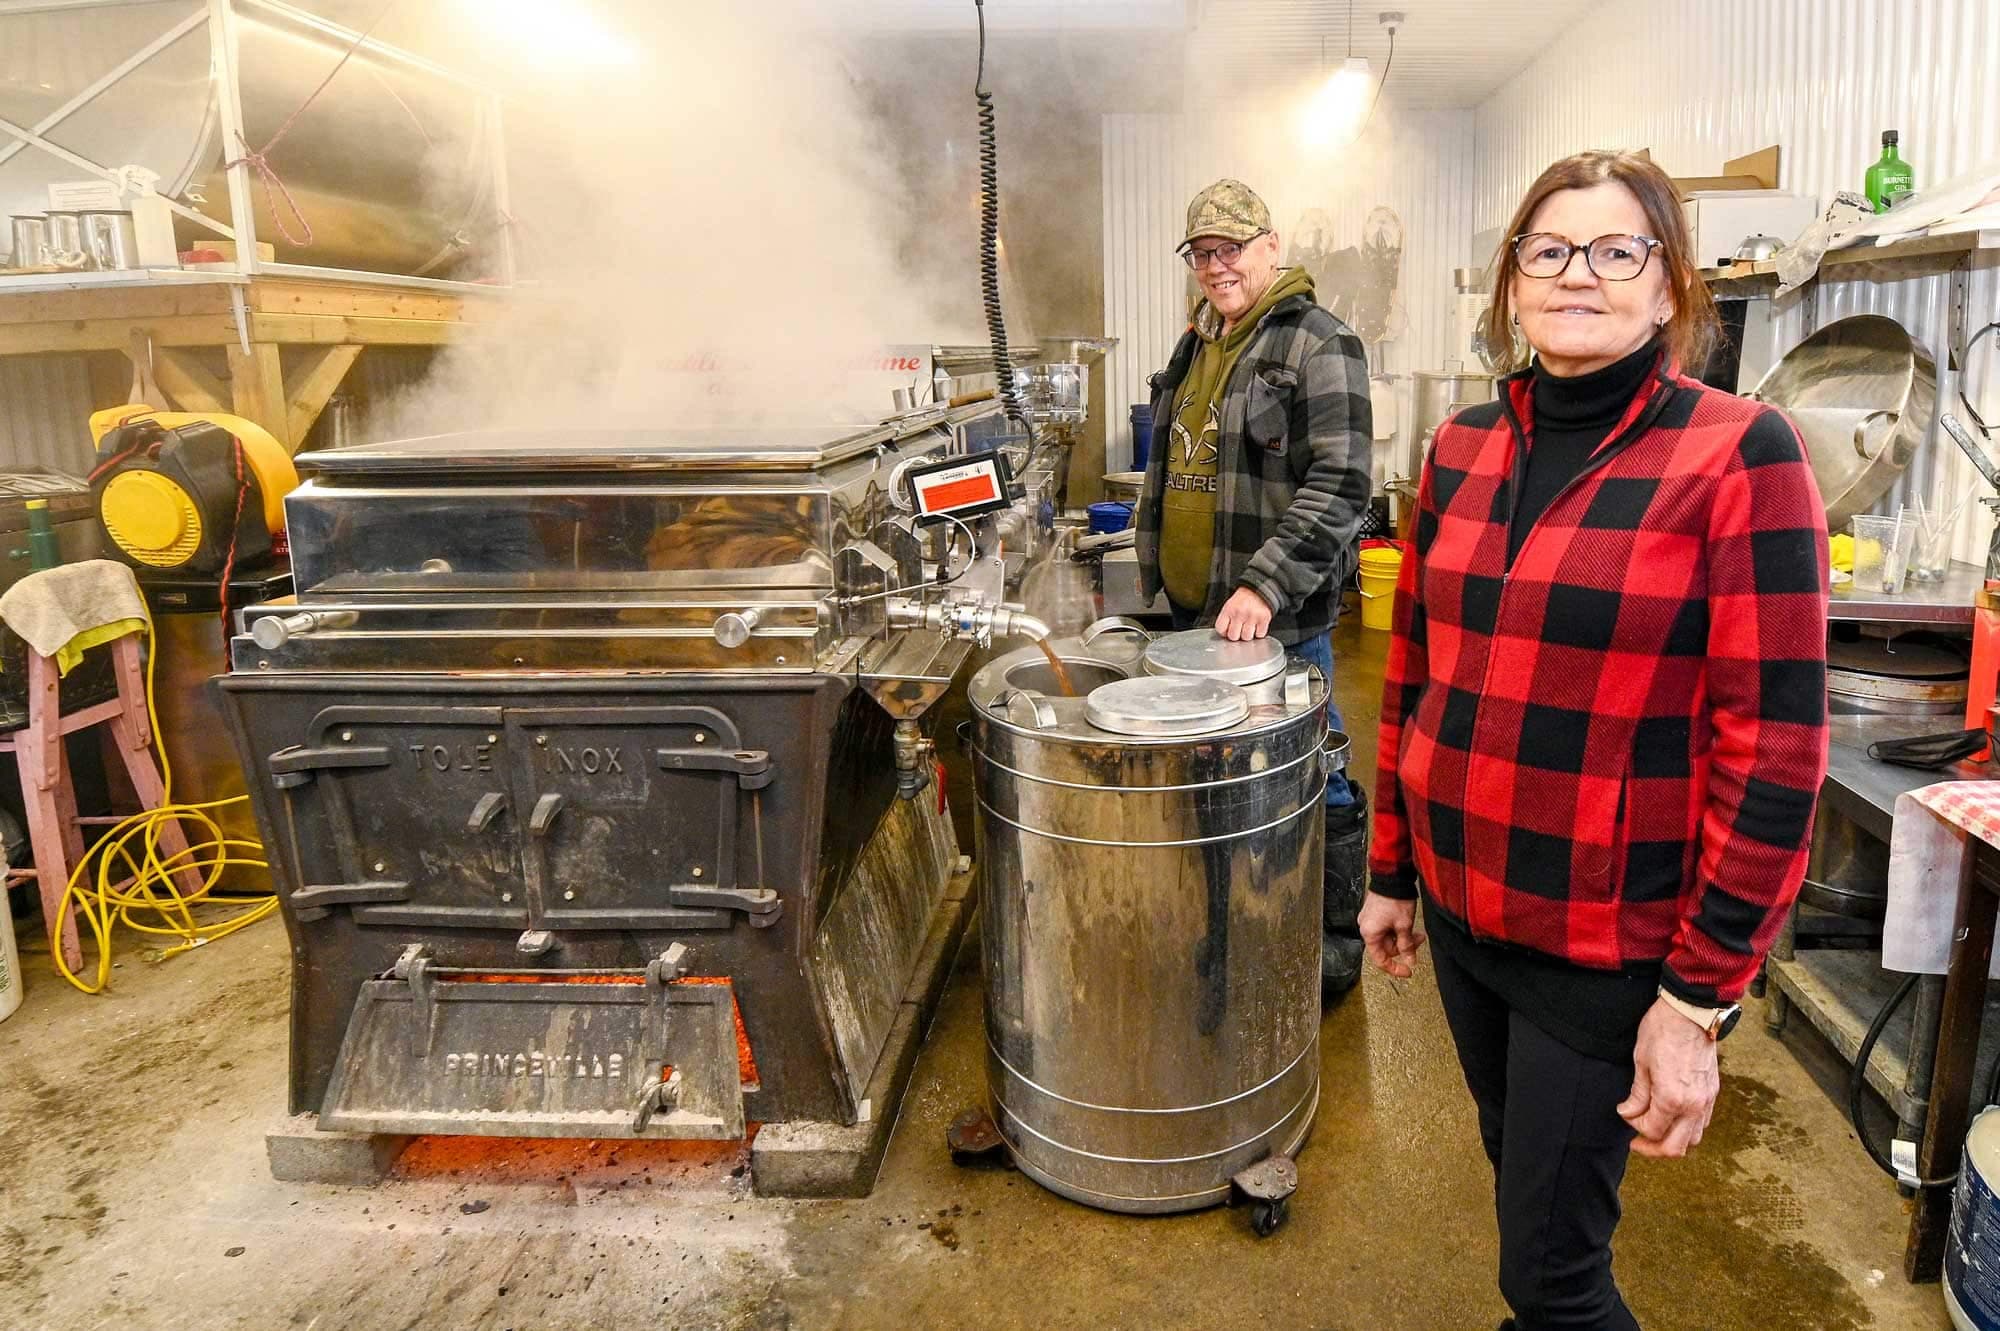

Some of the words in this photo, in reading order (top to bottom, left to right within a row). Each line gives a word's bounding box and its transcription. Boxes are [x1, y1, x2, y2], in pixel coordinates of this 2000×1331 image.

[1165, 472, 1217, 492] ALTRE
[409, 743, 493, 771] TOLE
[543, 746, 623, 774] INOX
